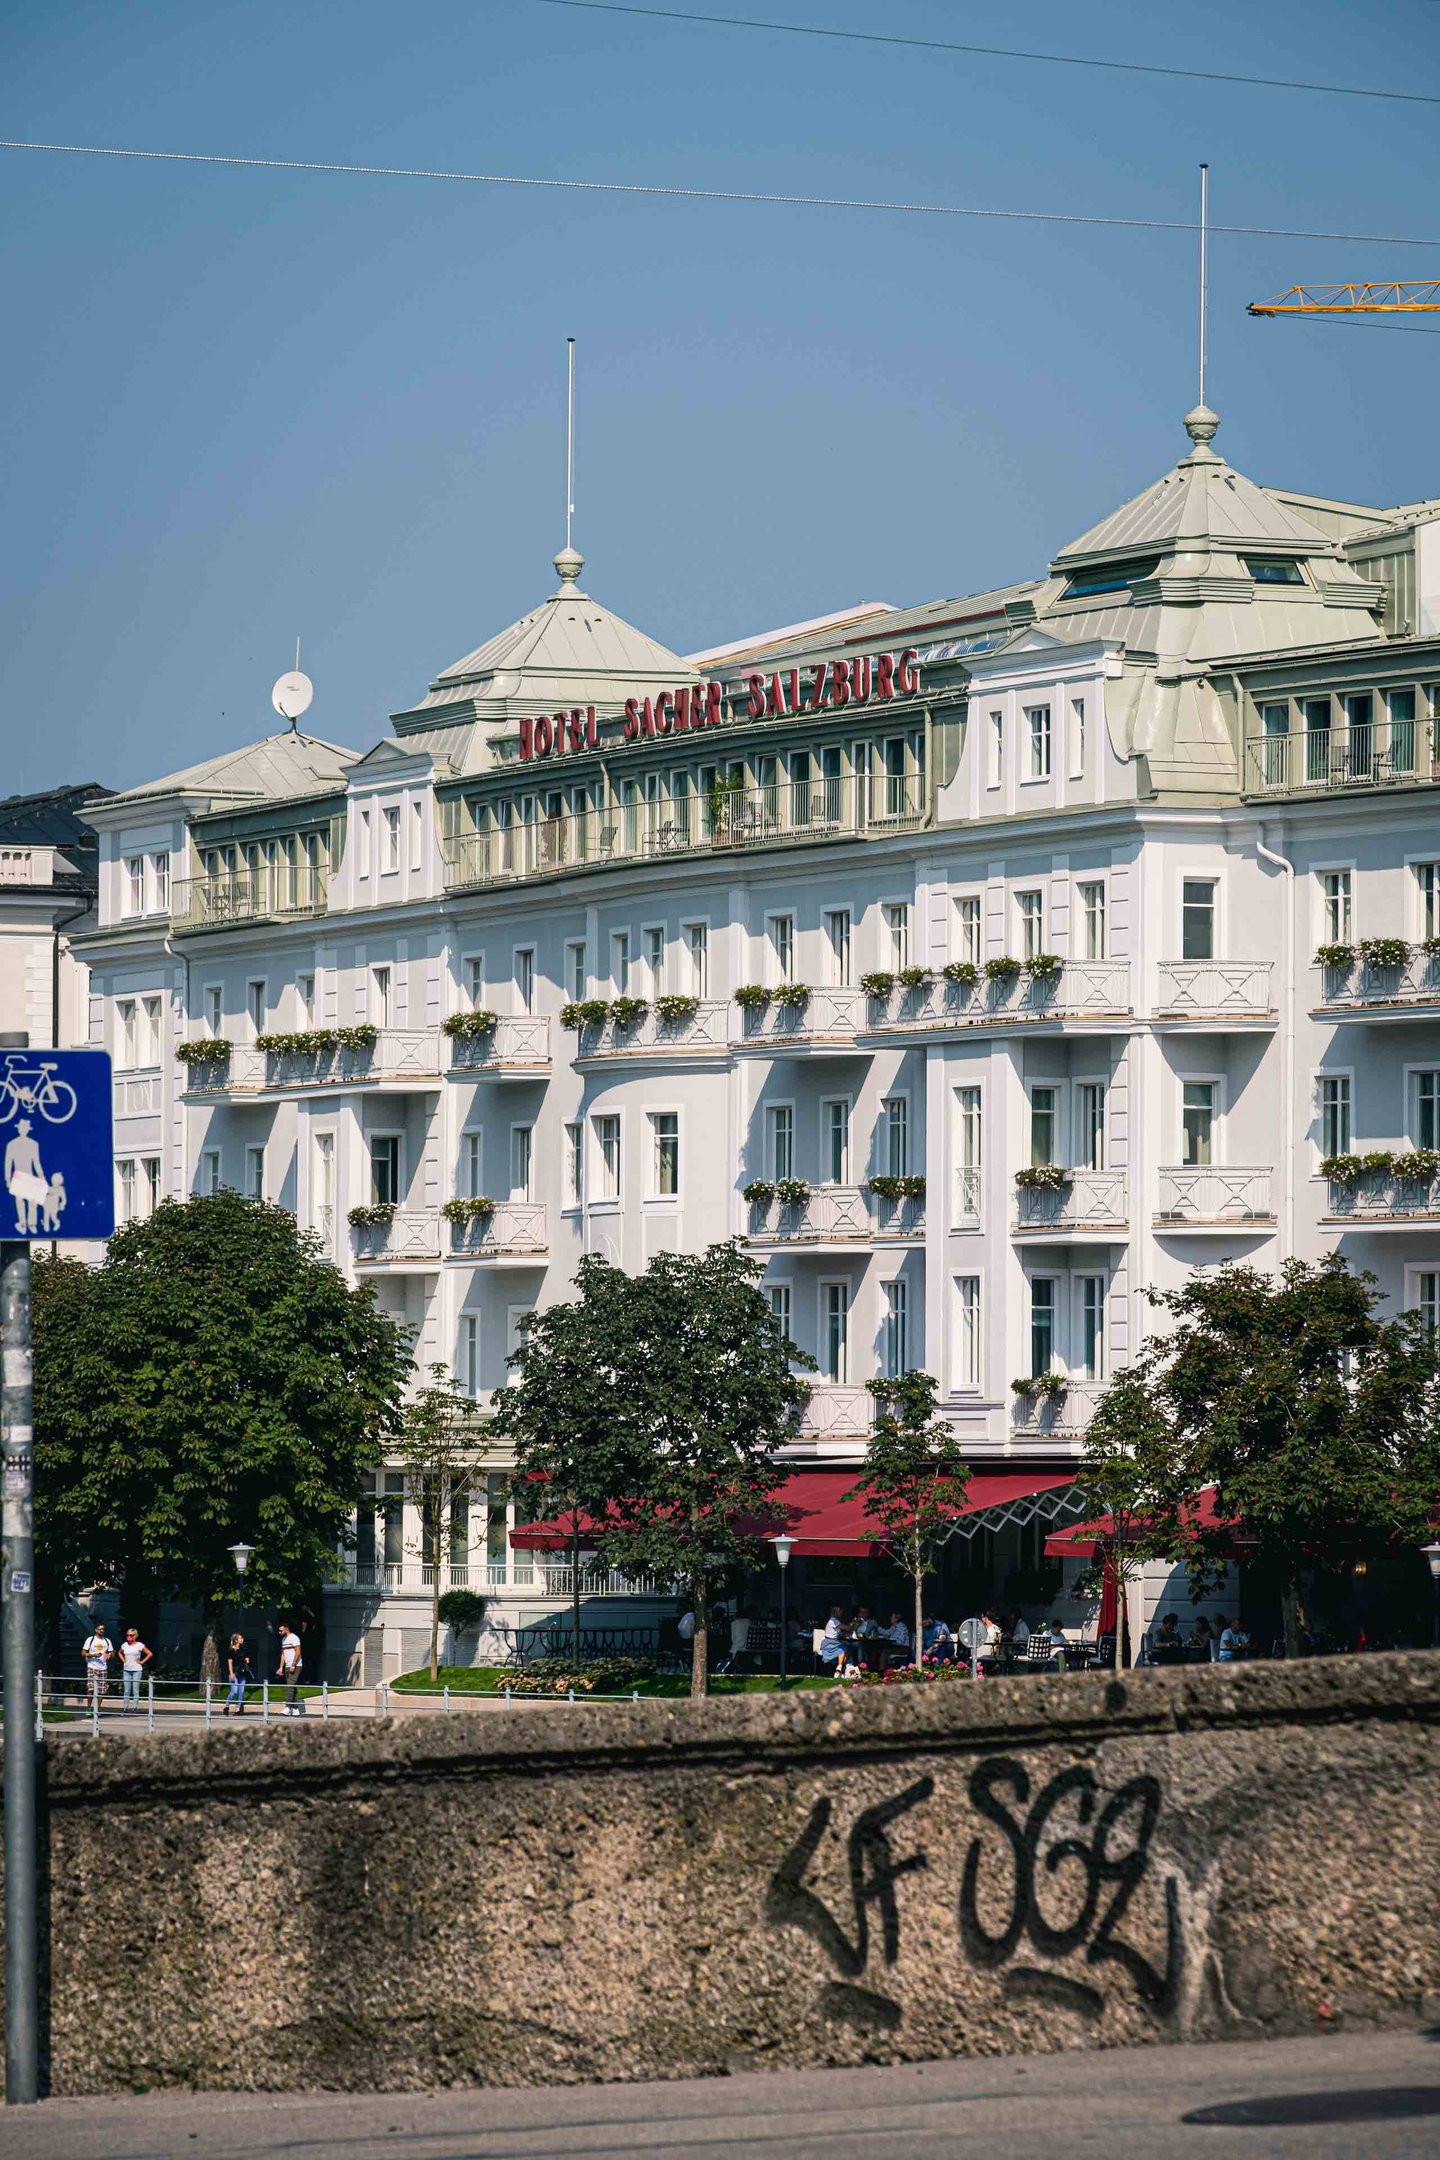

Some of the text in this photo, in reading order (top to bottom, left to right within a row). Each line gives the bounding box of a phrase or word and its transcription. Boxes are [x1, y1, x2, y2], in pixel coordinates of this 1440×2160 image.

[519, 648, 921, 760] HOTEL SACHER SALZBURG
